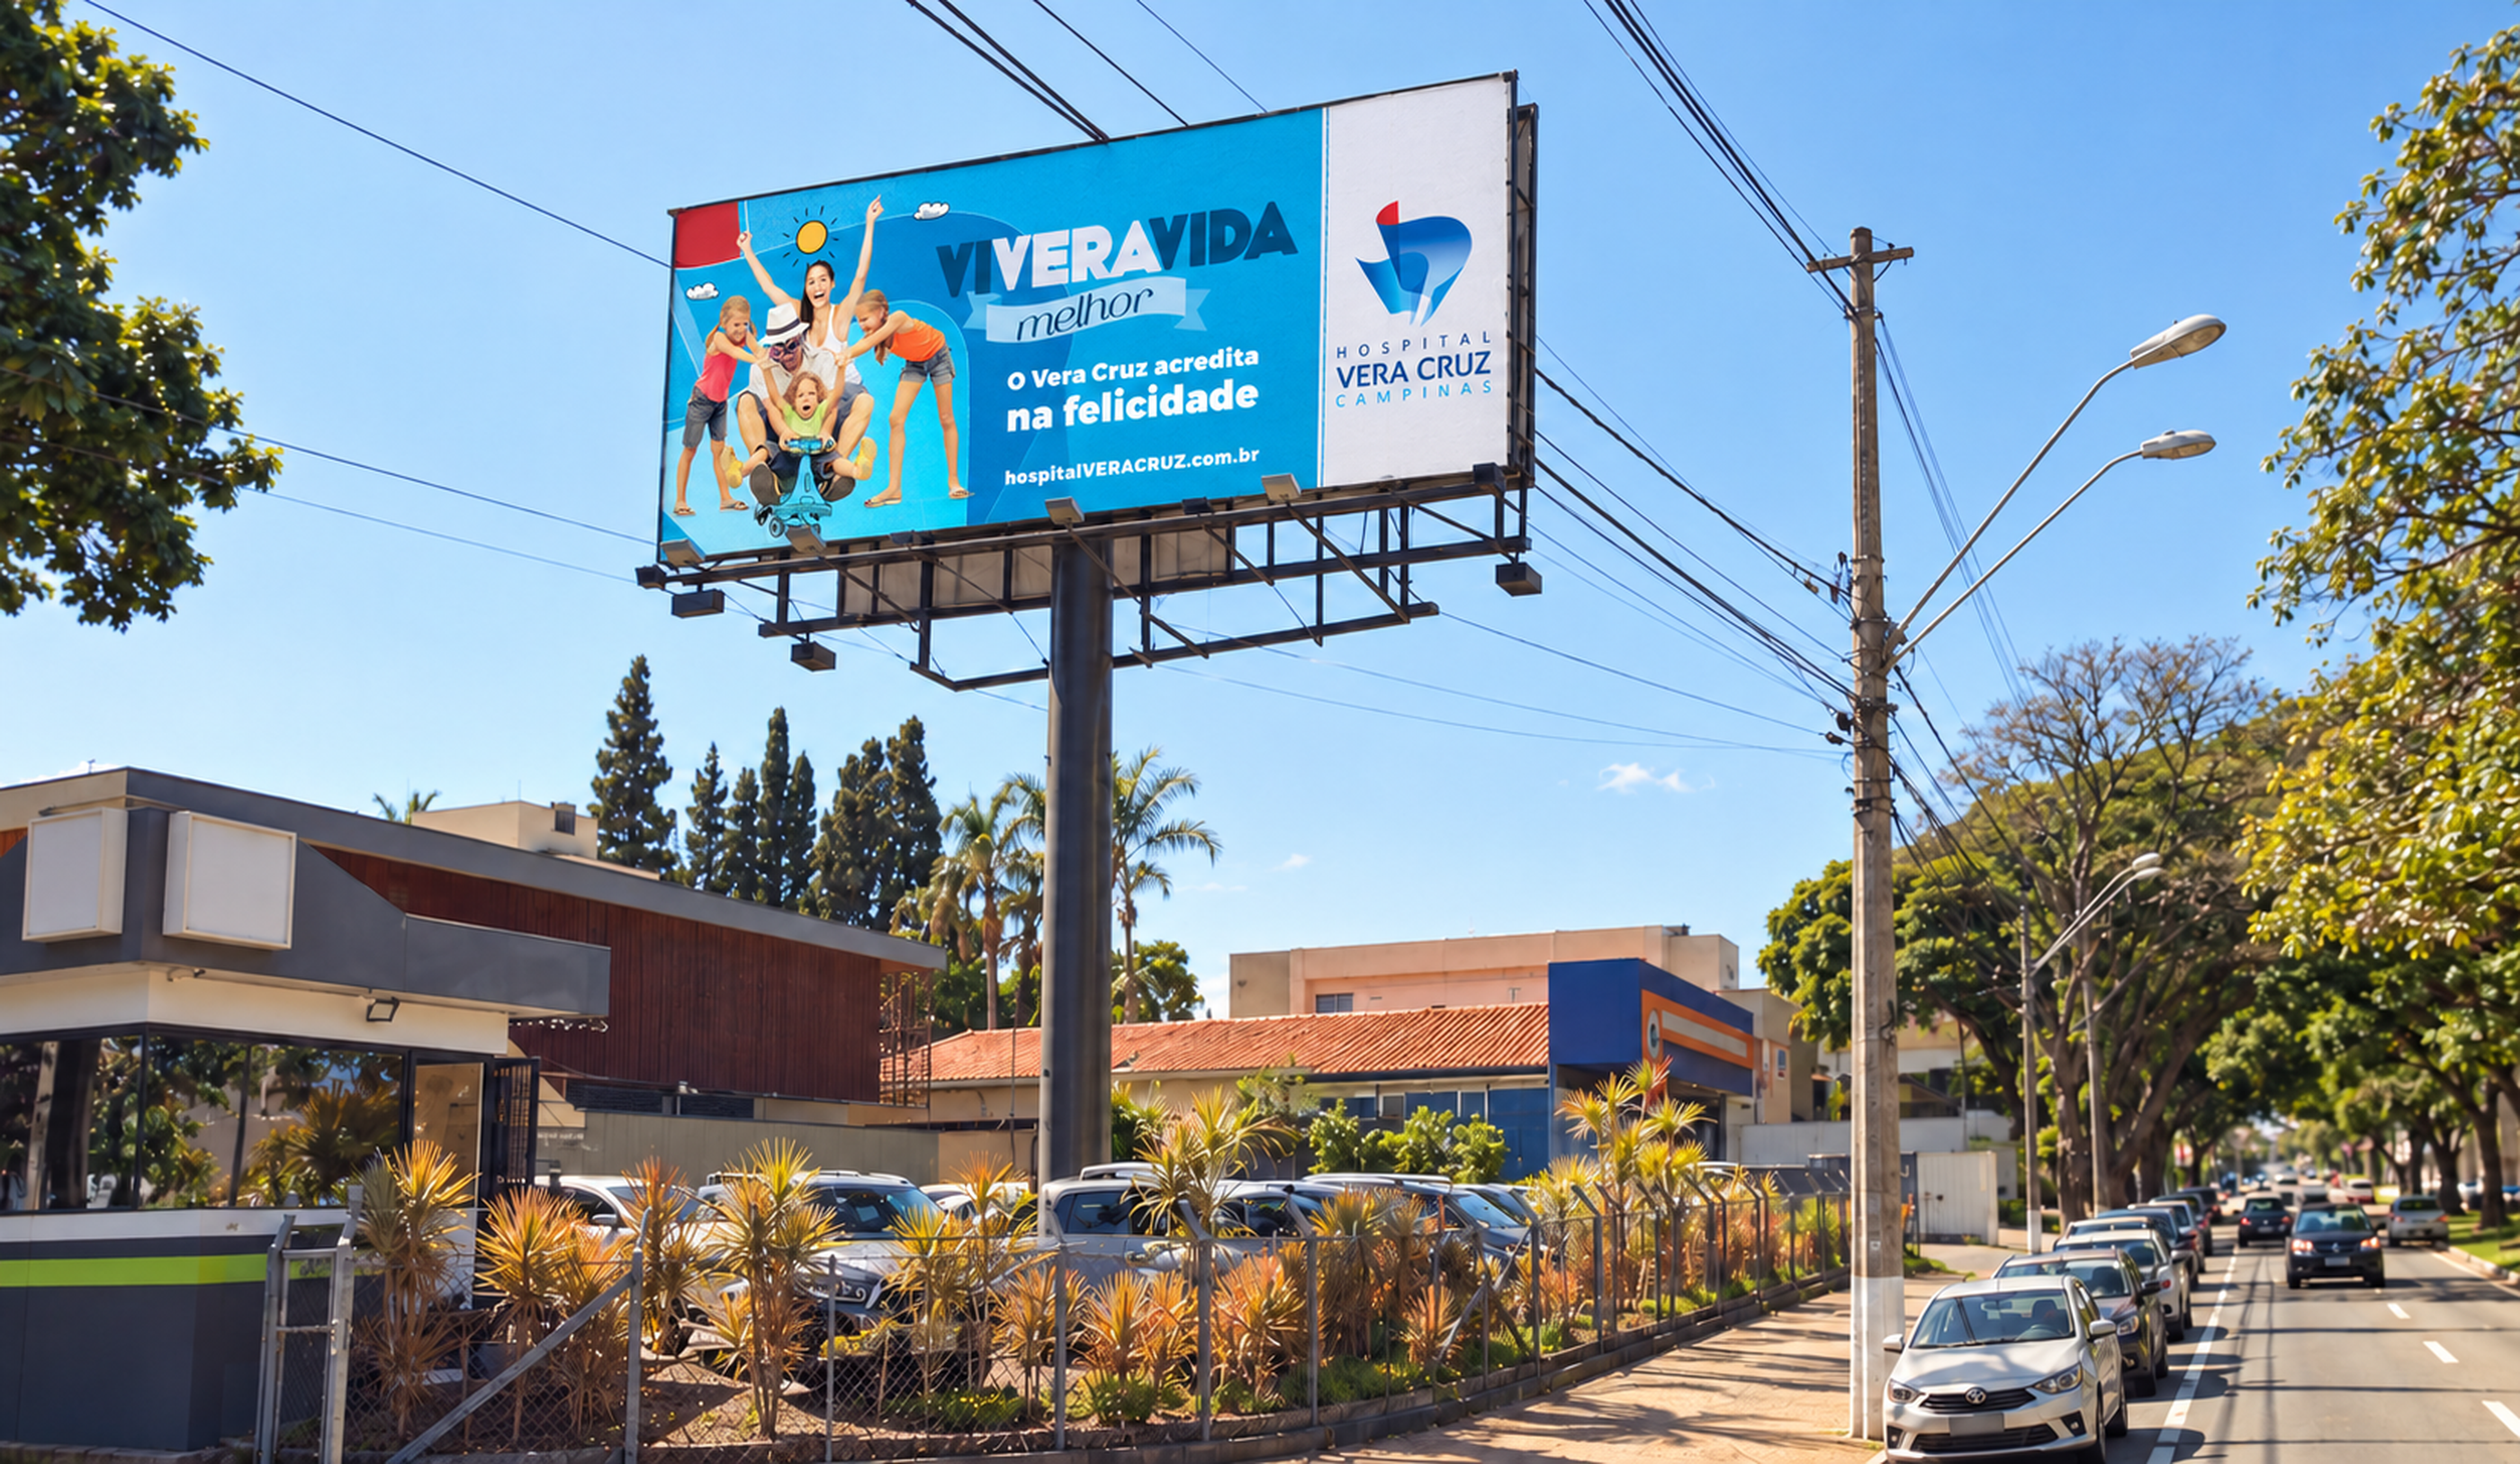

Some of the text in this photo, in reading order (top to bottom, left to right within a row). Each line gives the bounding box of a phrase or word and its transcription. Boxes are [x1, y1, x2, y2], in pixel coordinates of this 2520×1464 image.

[1016, 286, 1154, 342] melhor
[1336, 330, 1490, 359] HOSPITAL
[1007, 346, 1259, 391] O Vera Cruz acredita
[1336, 350, 1491, 389] VERA CRUZ
[1007, 378, 1259, 432] na felicidade
[1336, 380, 1491, 408] CAMPINAS
[1004, 447, 1260, 487] hospitalVERACRUZ.com.br
